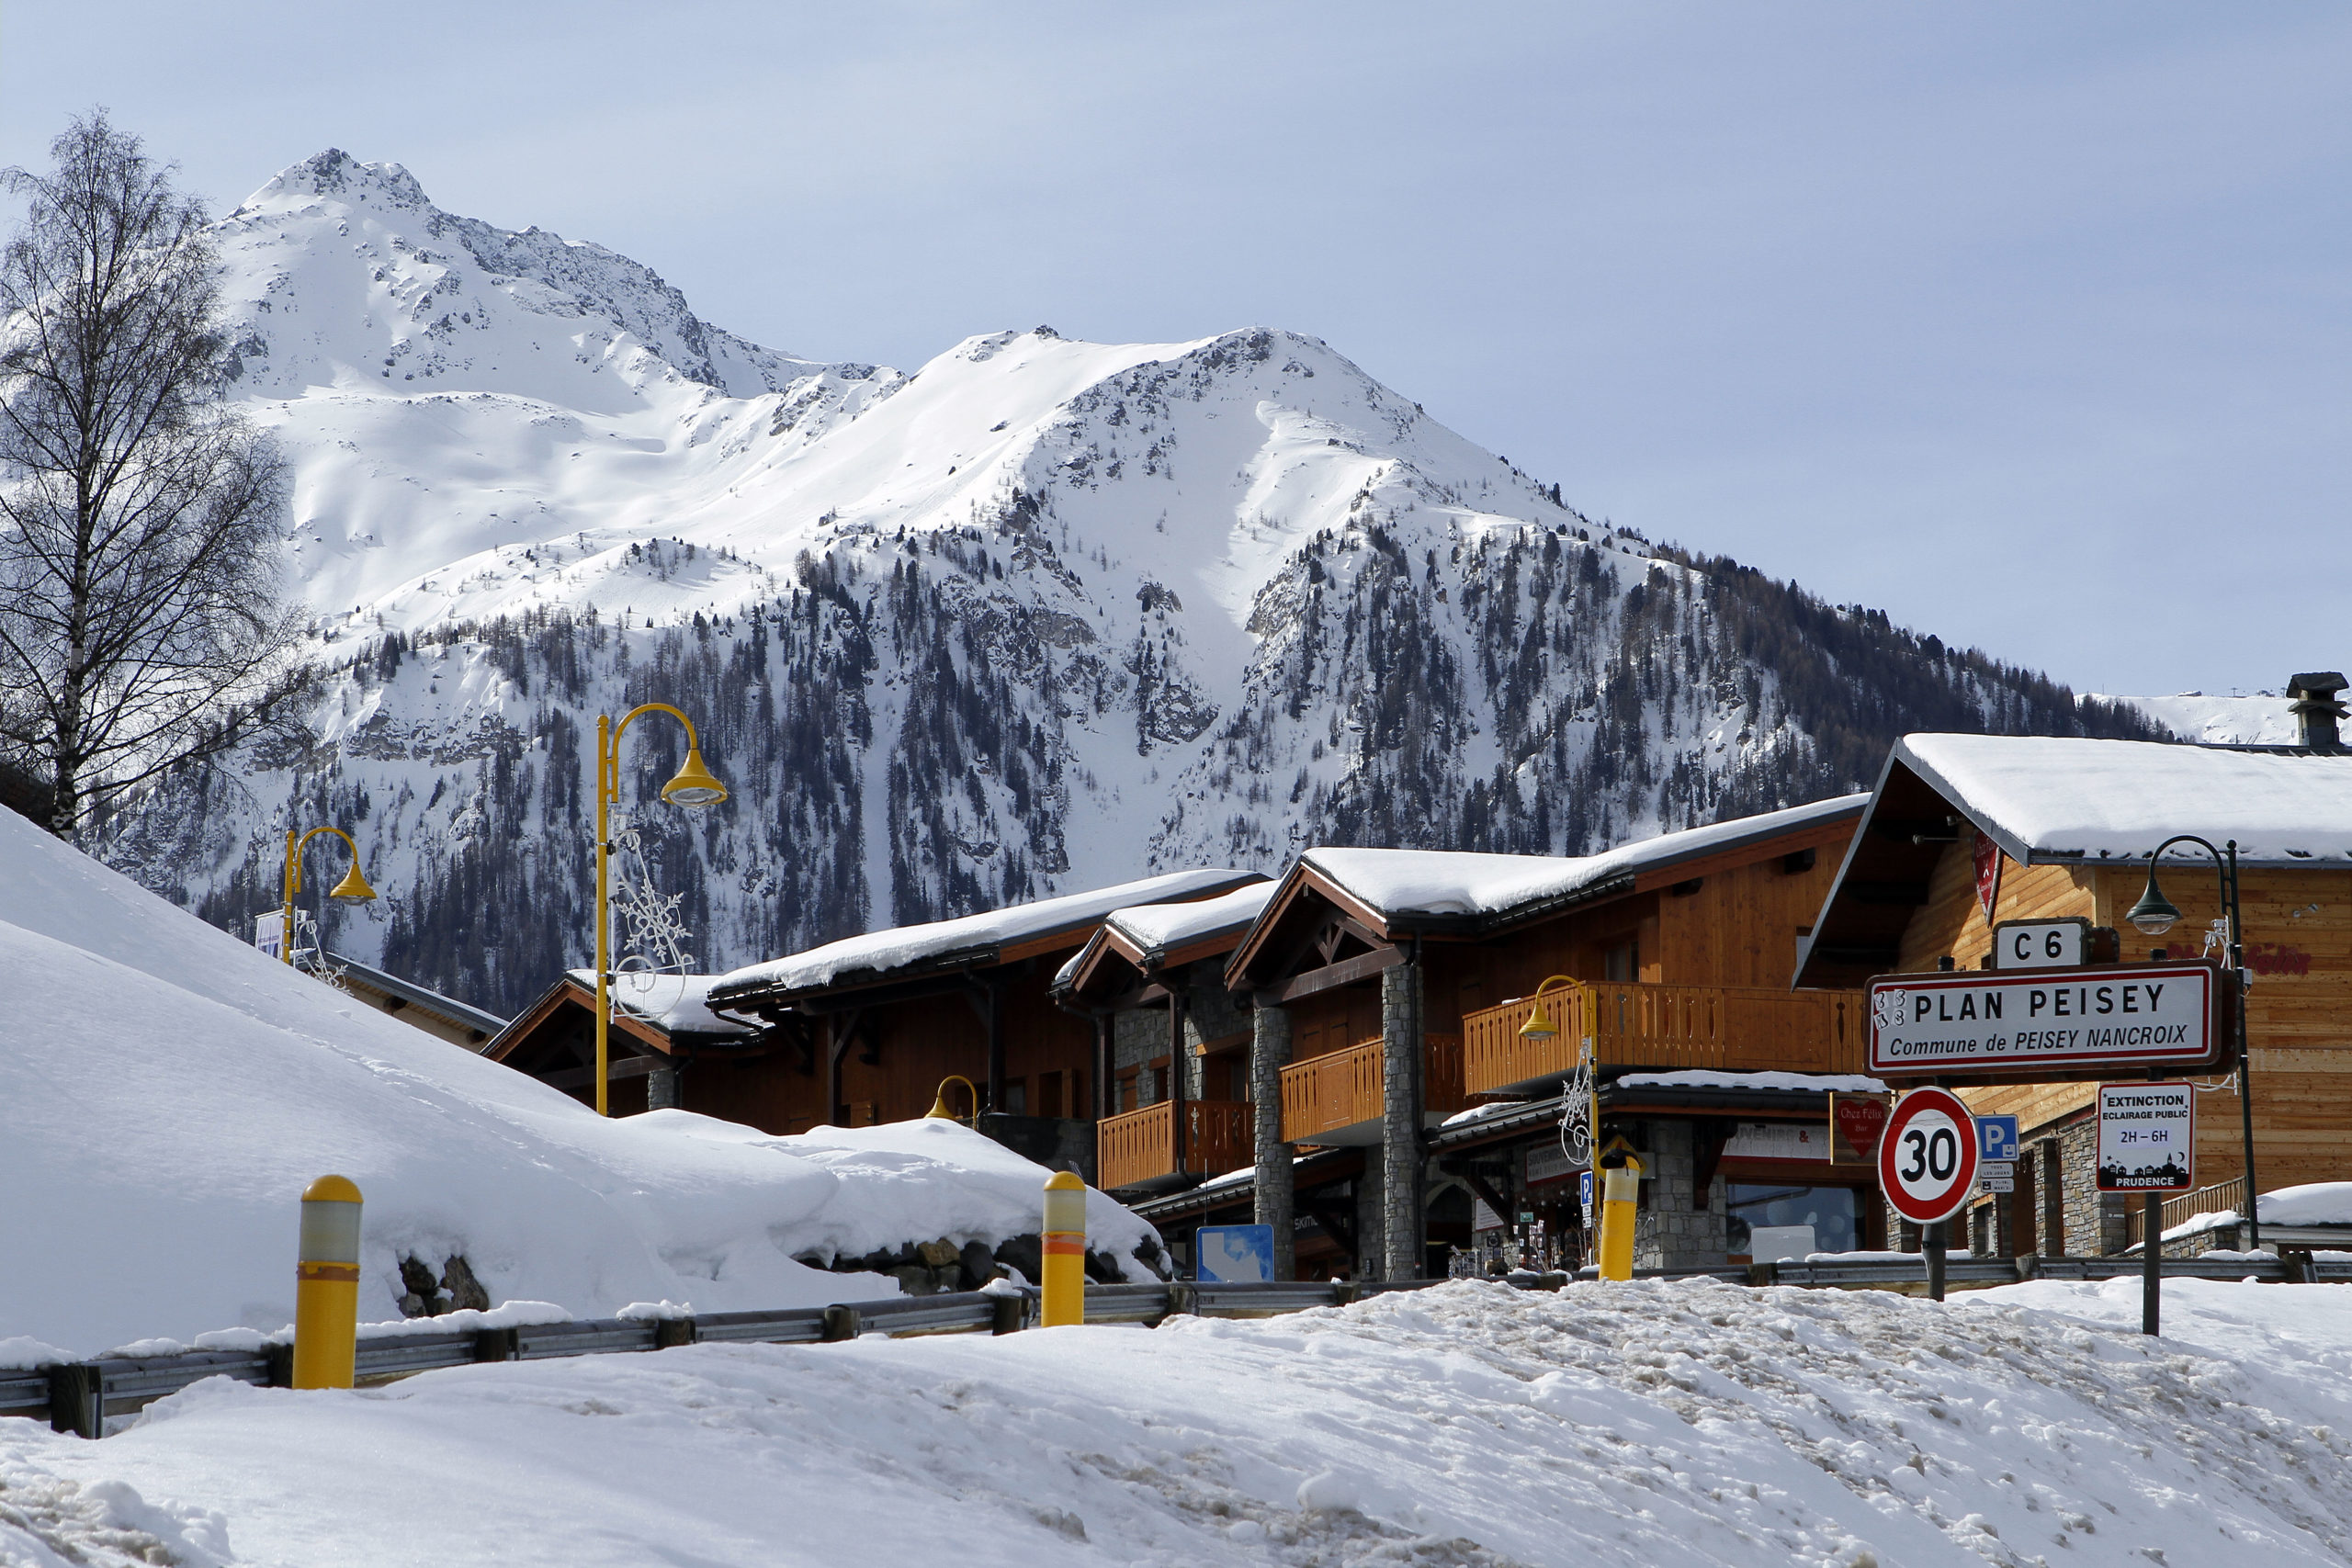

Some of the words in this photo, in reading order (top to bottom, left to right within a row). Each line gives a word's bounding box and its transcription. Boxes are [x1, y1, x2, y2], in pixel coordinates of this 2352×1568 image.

[2015, 932, 2031, 960] C
[2045, 931, 2063, 958] 6
[1915, 992, 2003, 1022] PLAN
[2030, 984, 2164, 1017] PEISEY
[1890, 1038, 1977, 1056] Commune
[1985, 1033, 2007, 1052] de
[2015, 1030, 2079, 1050] PEISEY
[2086, 1024, 2188, 1047] NANCROIX
[2107, 1095, 2184, 1108] EXTINCTION
[1840, 1107, 1860, 1119] Chez
[2102, 1111, 2153, 1121] ECLAIRAGE
[2154, 1110, 2188, 1119] PUBLIC
[1984, 1124, 2006, 1153] P
[2120, 1131, 2137, 1143] 2H
[2151, 1130, 2168, 1143] 6H
[1901, 1128, 1957, 1183] 30
[1583, 1179, 1589, 1201] P
[2116, 1177, 2175, 1187] PRUDENCE
